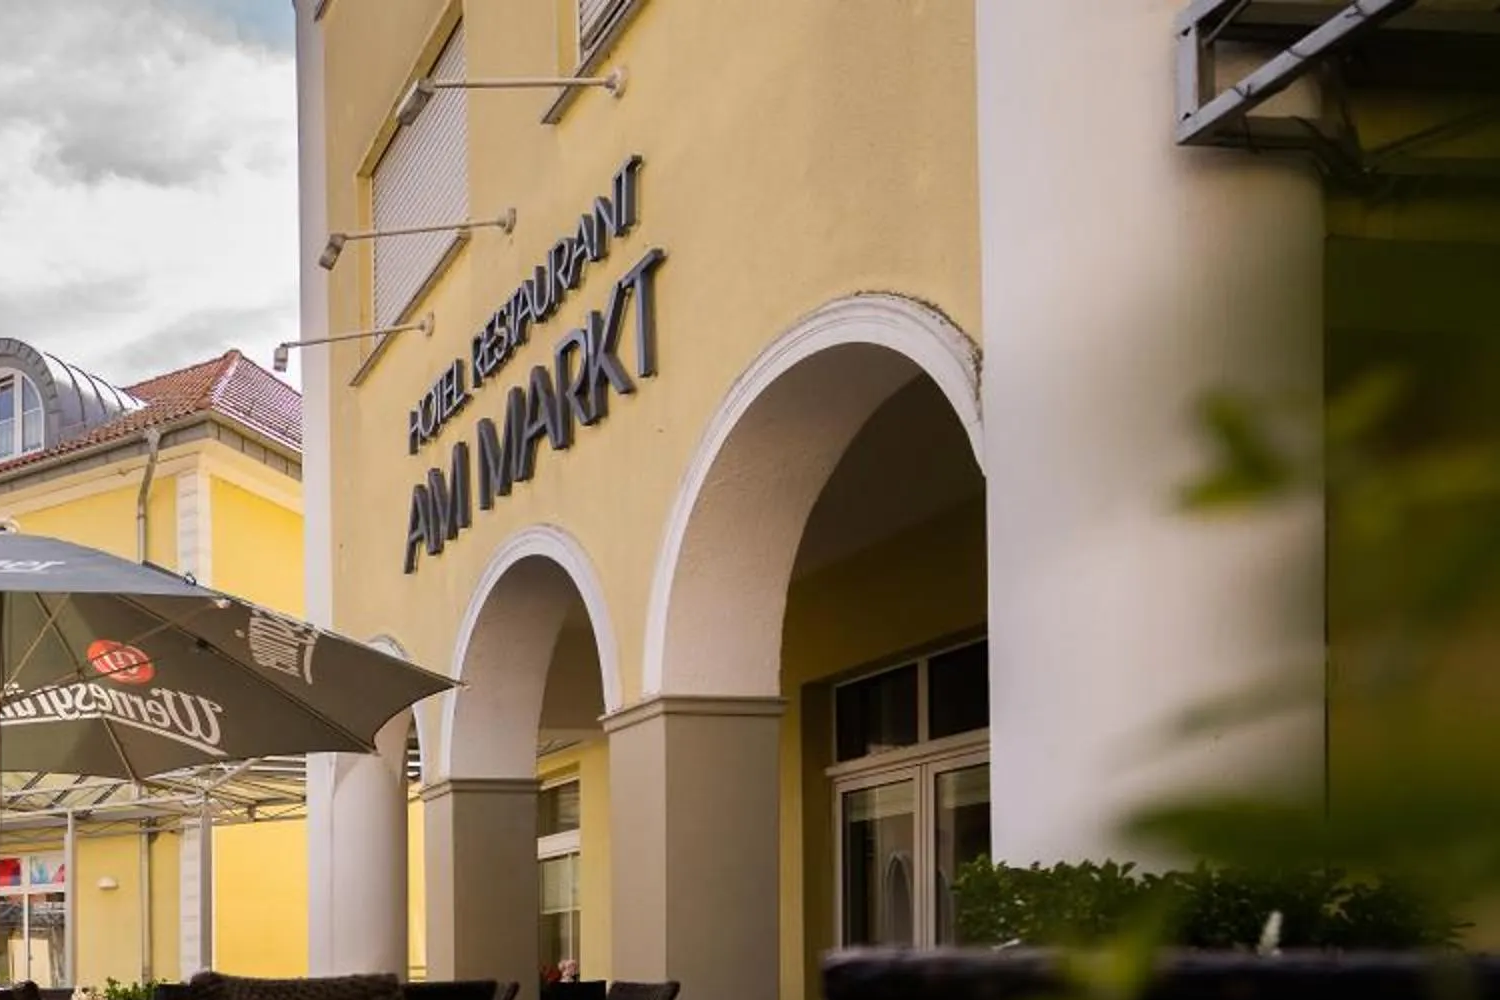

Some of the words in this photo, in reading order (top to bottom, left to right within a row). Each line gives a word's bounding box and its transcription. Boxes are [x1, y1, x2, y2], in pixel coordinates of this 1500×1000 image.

[403, 442, 473, 575] AM
[477, 247, 668, 512] MARKT
[408, 358, 472, 455] HOTEL
[471, 154, 643, 389] RESTAURANT
